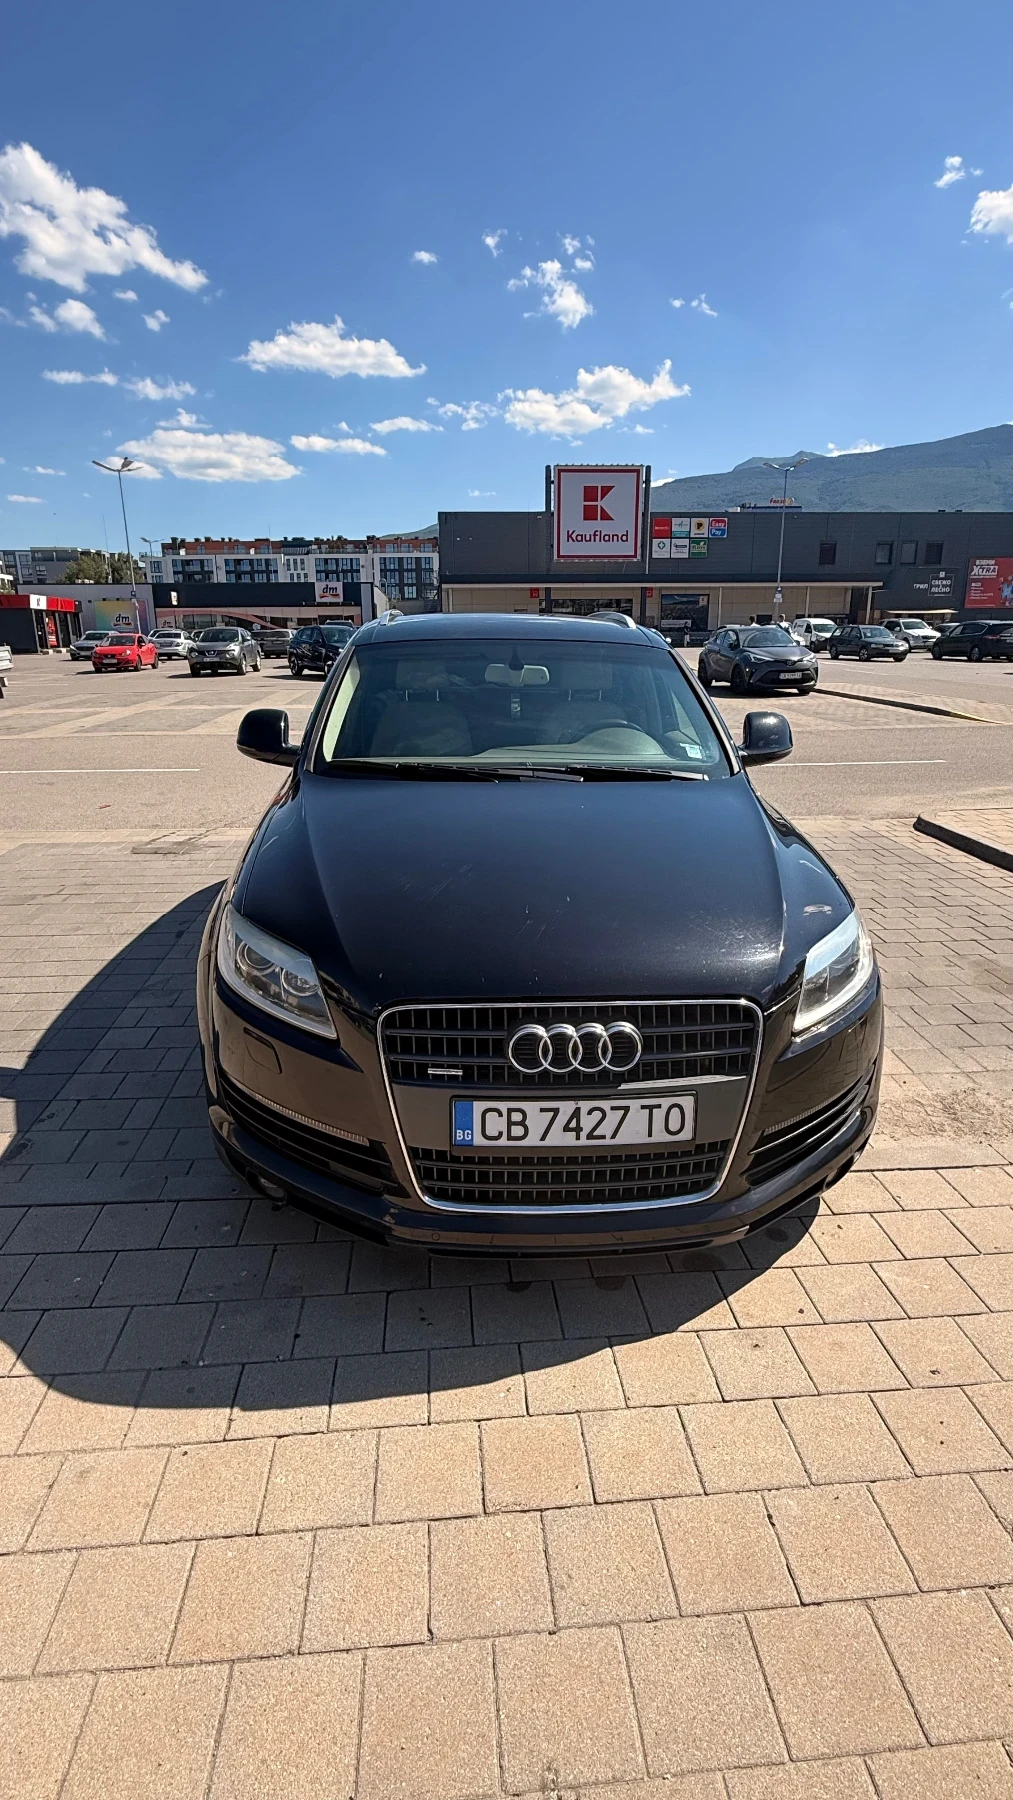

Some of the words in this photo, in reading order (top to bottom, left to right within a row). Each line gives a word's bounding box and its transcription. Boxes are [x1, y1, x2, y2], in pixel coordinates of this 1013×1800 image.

[566, 529, 629, 543] Kaufland
[322, 584, 338, 595] dm
[115, 613, 130, 623] dm
[480, 1107, 529, 1142] CB
[538, 1105, 631, 1142] 7427
[640, 1102, 686, 1138] TO
[456, 1129, 472, 1141] BG
